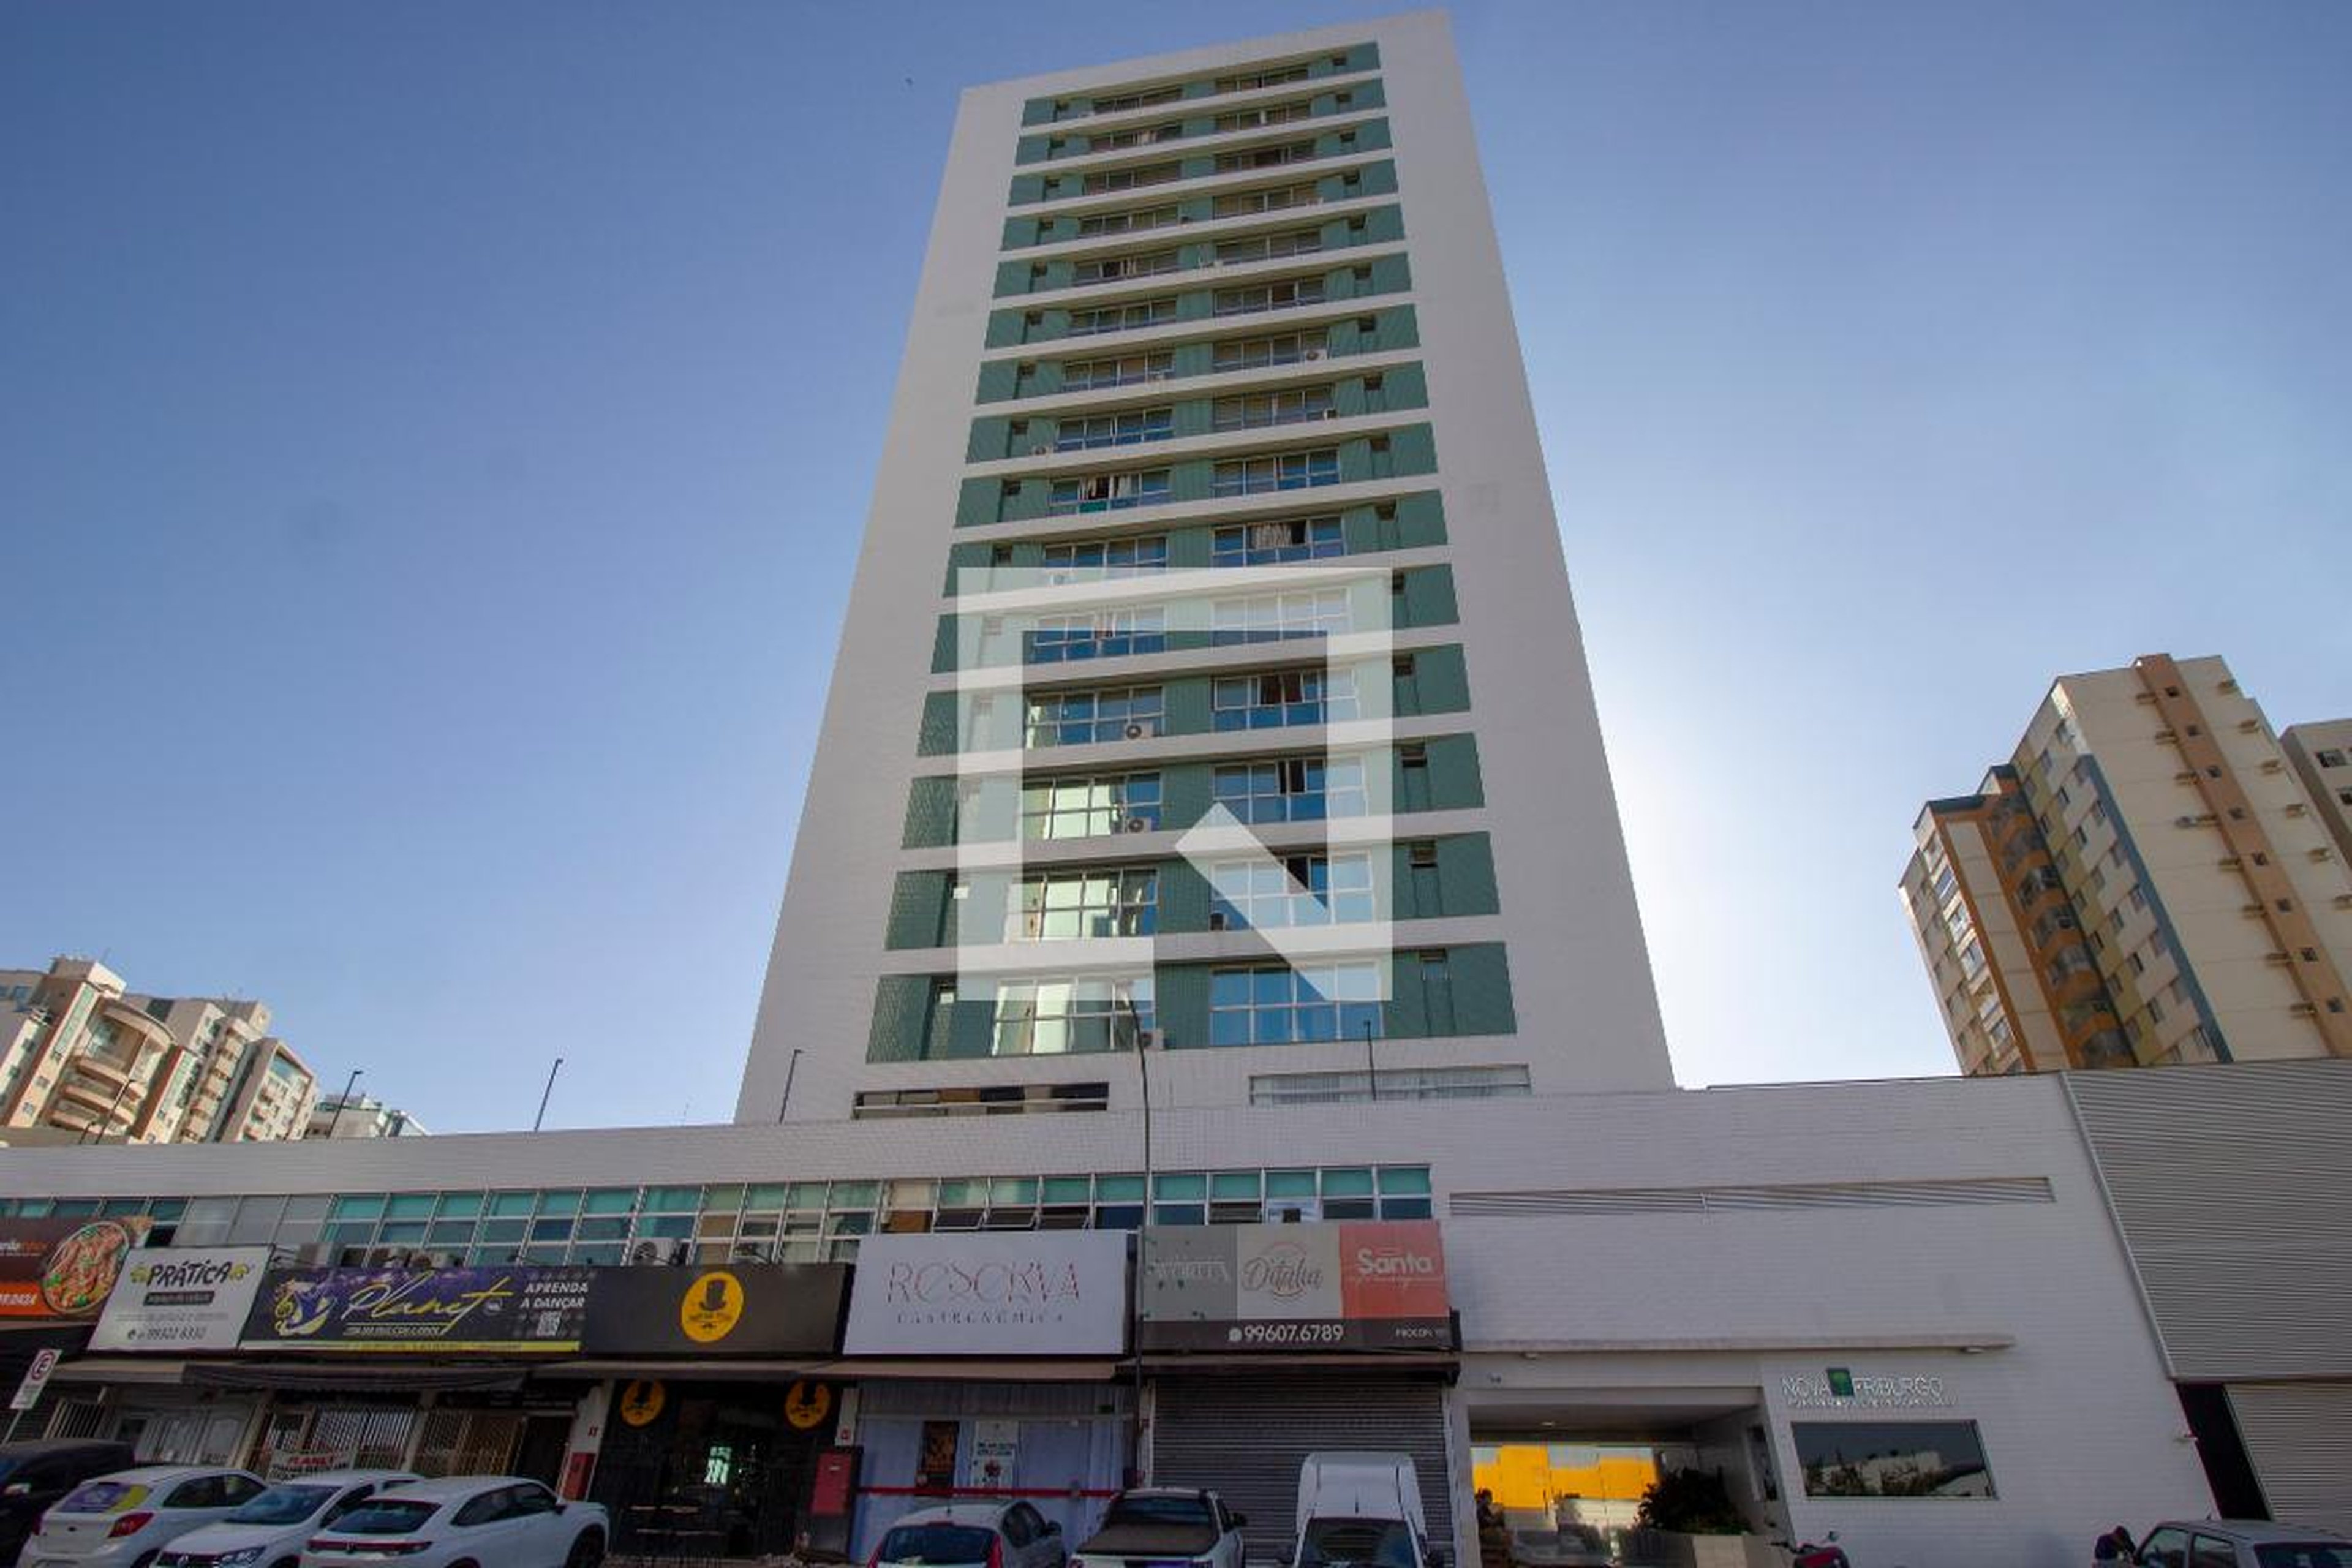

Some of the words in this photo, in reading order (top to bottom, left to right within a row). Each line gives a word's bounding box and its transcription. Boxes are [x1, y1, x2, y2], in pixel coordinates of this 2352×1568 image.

[1356, 1248, 1433, 1275] Santa
[524, 1281, 589, 1294] APRENDA
[520, 1298, 530, 1308] A
[1243, 1323, 1344, 1343] 99607.6789
